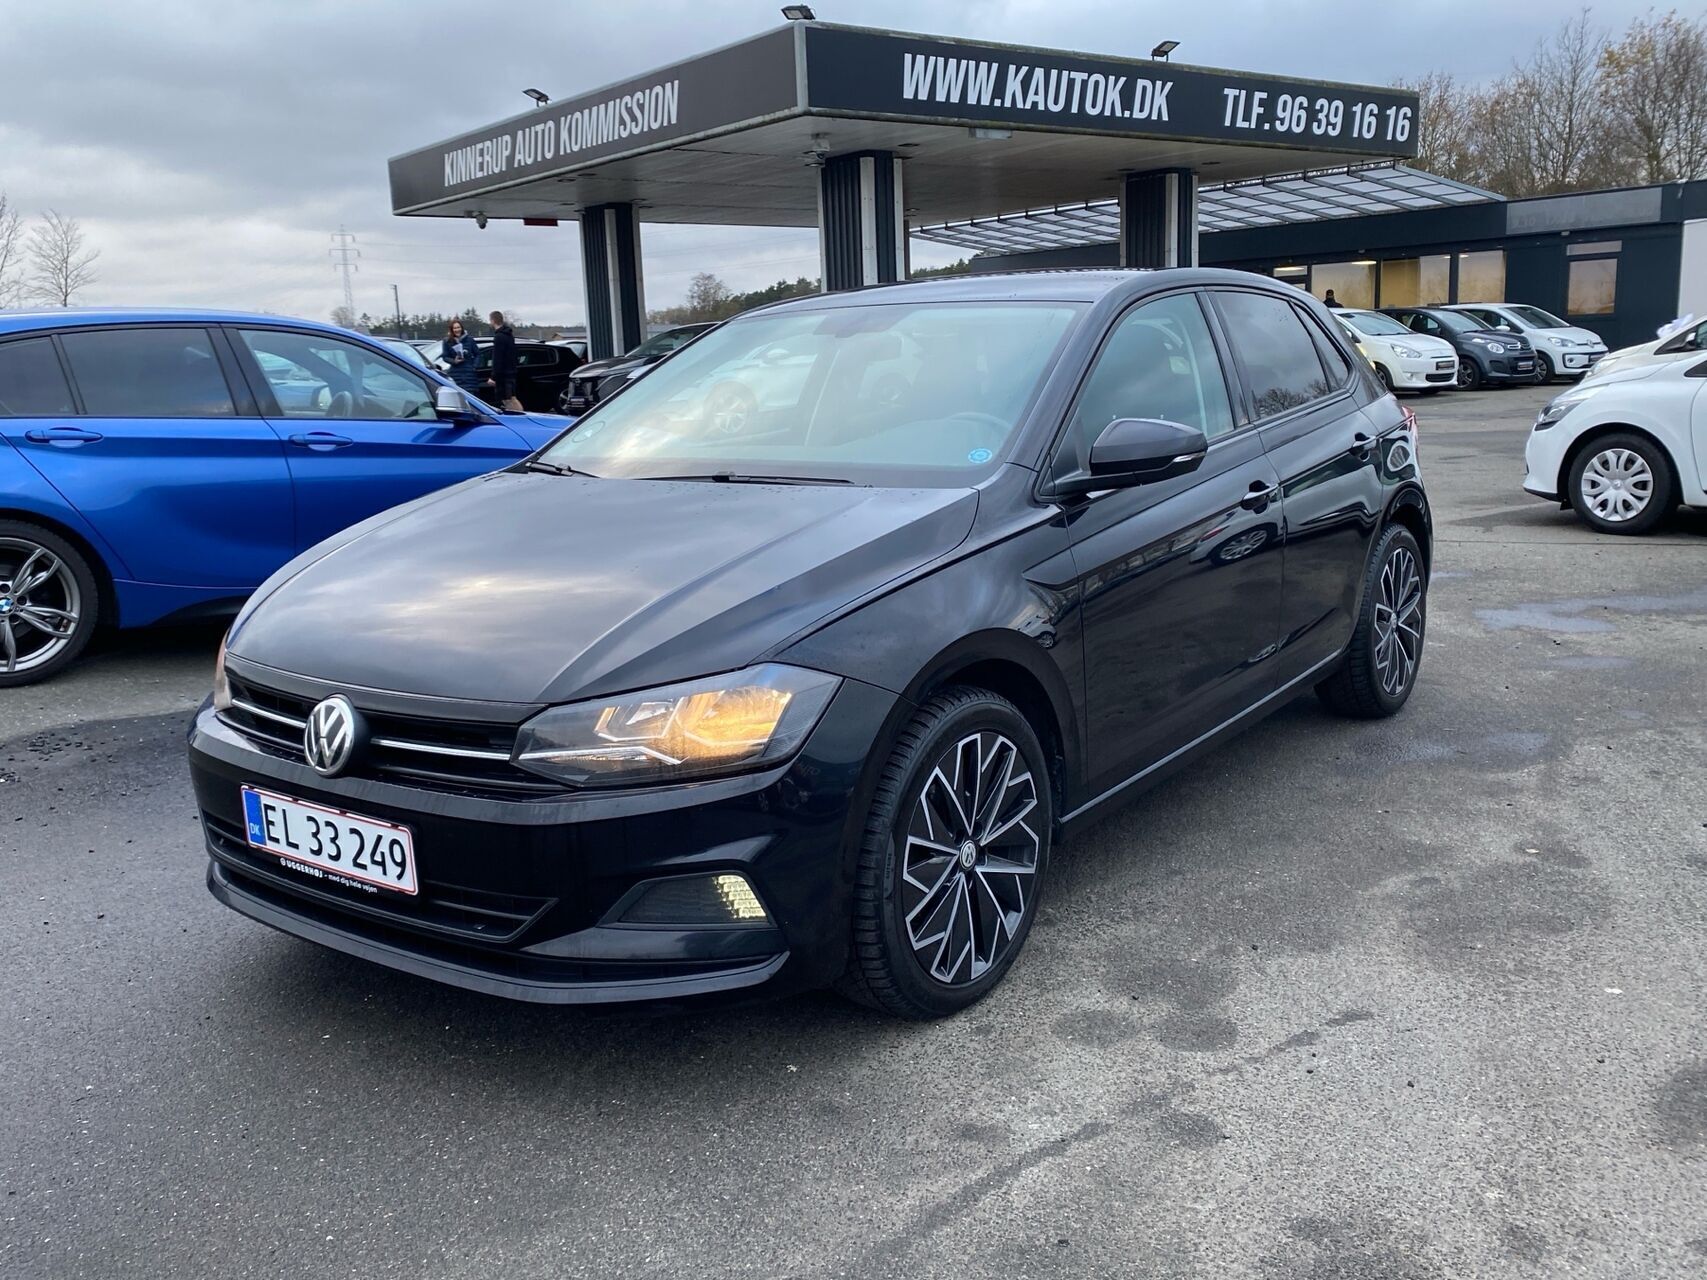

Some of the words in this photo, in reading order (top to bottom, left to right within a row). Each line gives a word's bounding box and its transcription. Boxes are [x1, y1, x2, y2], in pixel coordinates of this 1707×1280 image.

[903, 53, 1173, 122] WWW.KAUTOK.DK
[1275, 94, 1308, 133] 96
[1312, 98, 1344, 136] 39
[1352, 102, 1379, 139] 16
[1386, 106, 1412, 142] 16
[444, 134, 511, 187] KINNERUP
[514, 121, 555, 168] AUTO
[559, 80, 679, 155] KOMMISSION
[250, 822, 261, 836] DK
[263, 803, 299, 850] EL
[306, 816, 341, 862] 33
[349, 828, 407, 881] 249
